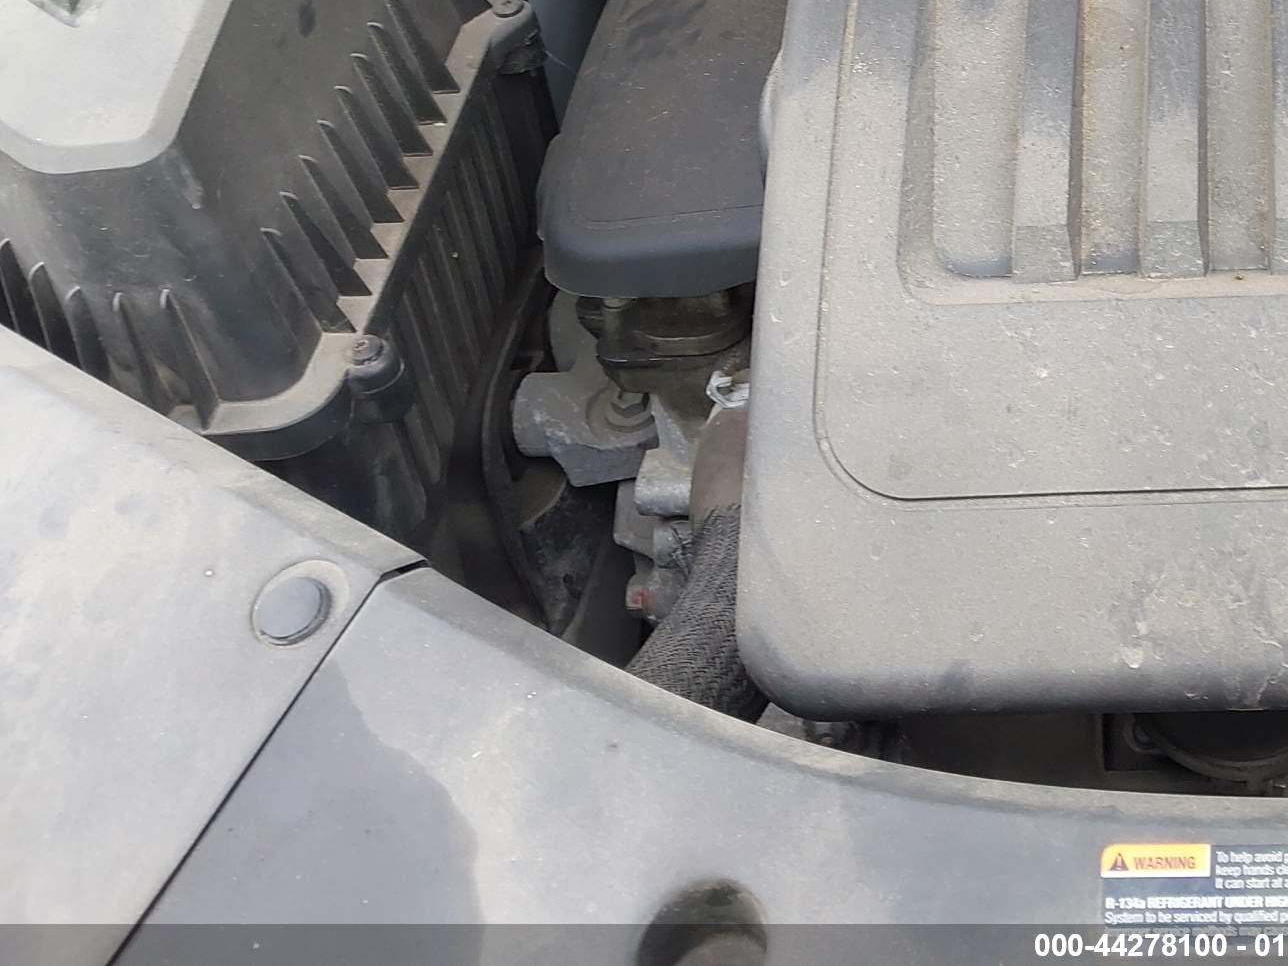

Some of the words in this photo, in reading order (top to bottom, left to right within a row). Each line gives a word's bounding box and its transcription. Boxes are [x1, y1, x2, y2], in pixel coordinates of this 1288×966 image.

[1134, 856, 1197, 871] WARNING
[1216, 851, 1229, 863] To
[1230, 851, 1253, 864] help
[1254, 851, 1283, 863] avoid
[1215, 864, 1241, 877] keep
[1243, 865, 1275, 876] hands
[1225, 879, 1244, 889] can
[1245, 878, 1270, 889] start
[1271, 877, 1283, 889] at
[1105, 897, 1146, 909] R-134a
[1147, 896, 1224, 909] REFRIGERANT
[1224, 895, 1263, 908] UNDER
[1105, 912, 1144, 924] System
[1145, 913, 1157, 923] to
[1158, 913, 1172, 923] be
[1173, 911, 1218, 923] serviced
[1219, 911, 1233, 924] by
[1234, 911, 1278, 923] qualified
